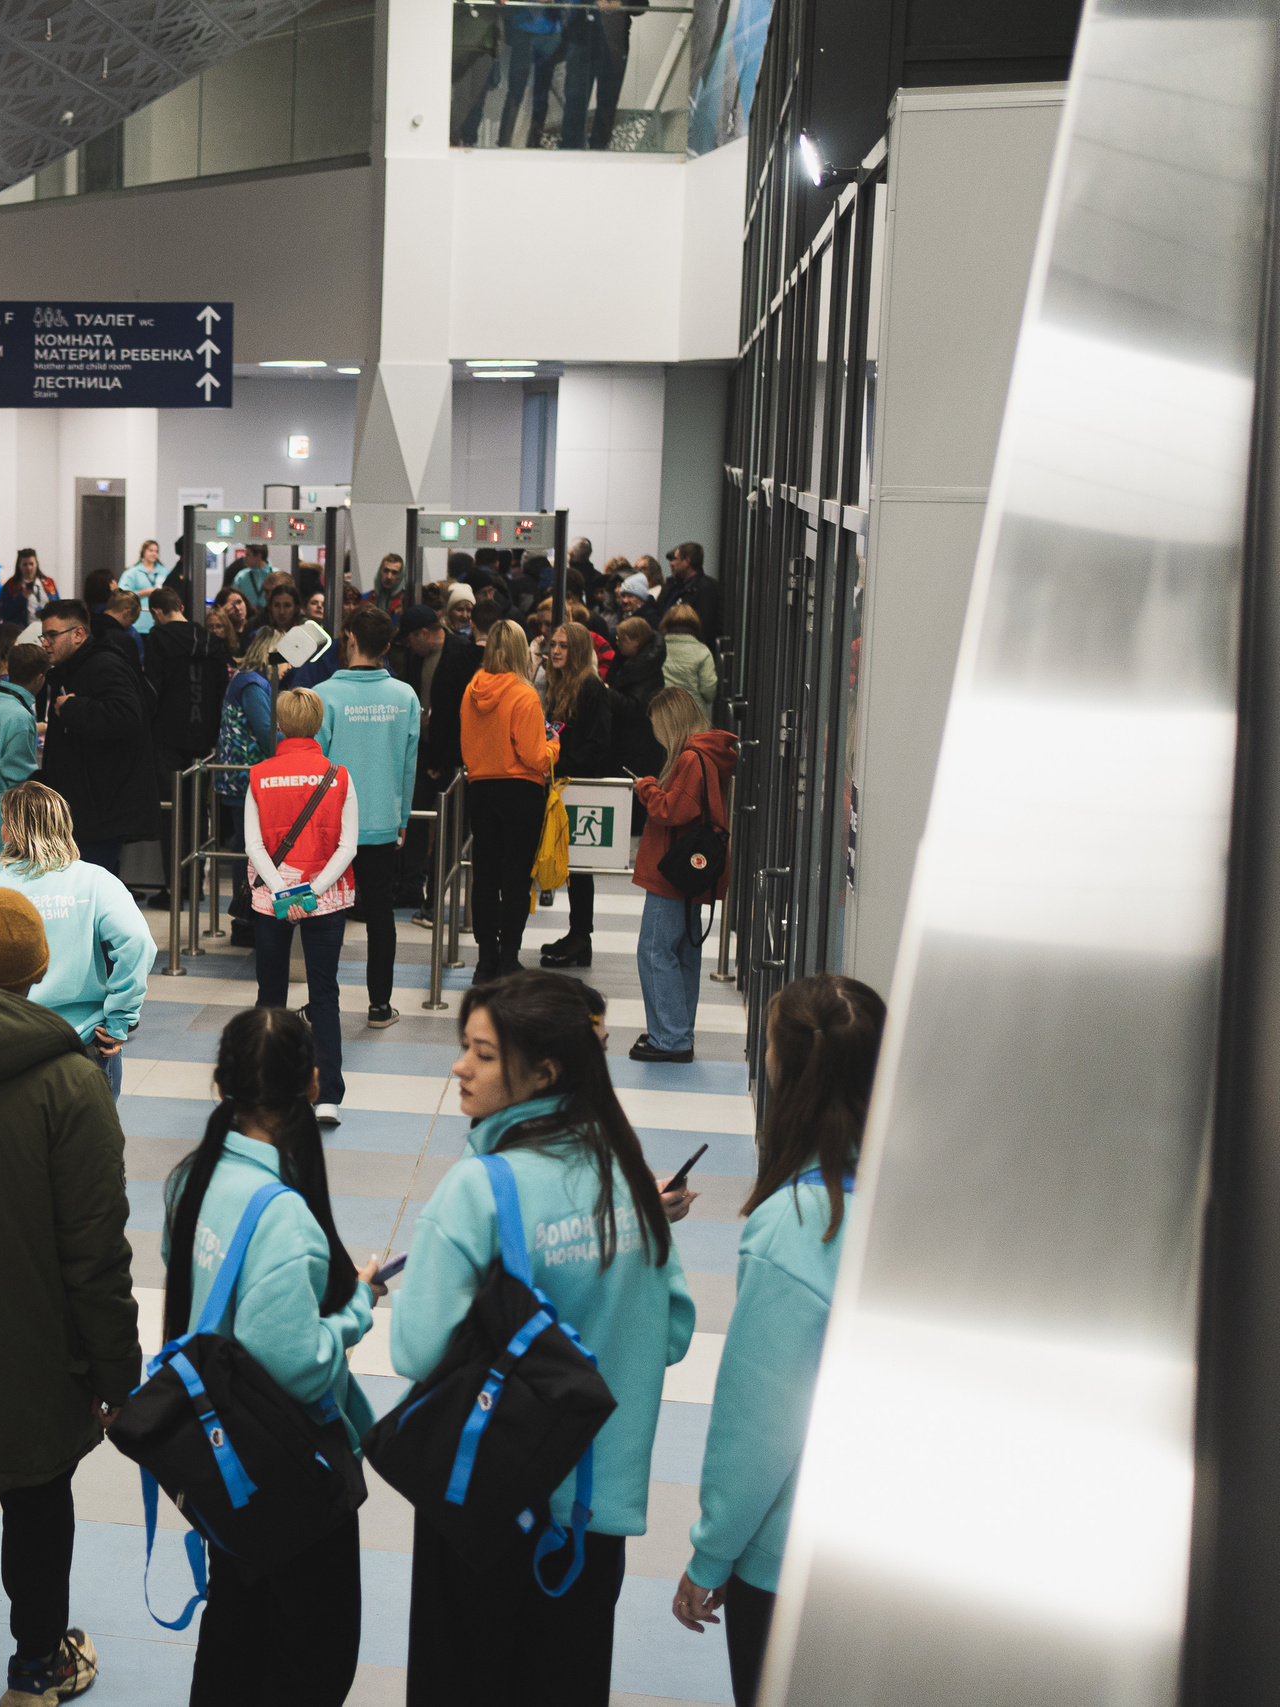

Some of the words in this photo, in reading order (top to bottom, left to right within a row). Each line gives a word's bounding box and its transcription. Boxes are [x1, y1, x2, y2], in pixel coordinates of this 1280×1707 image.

[5, 312, 15, 325] F
[74, 313, 136, 327] ТУАЛЕТ
[34, 334, 115, 347] КОМНАТА
[34, 349, 100, 362] МАТЕРИ
[104, 349, 117, 362] И
[120, 349, 194, 362] РЕБЕНКА
[67, 363, 84, 371] and
[33, 376, 122, 391] ЛЕСТНИЦА
[33, 390, 58, 398] Stairs
